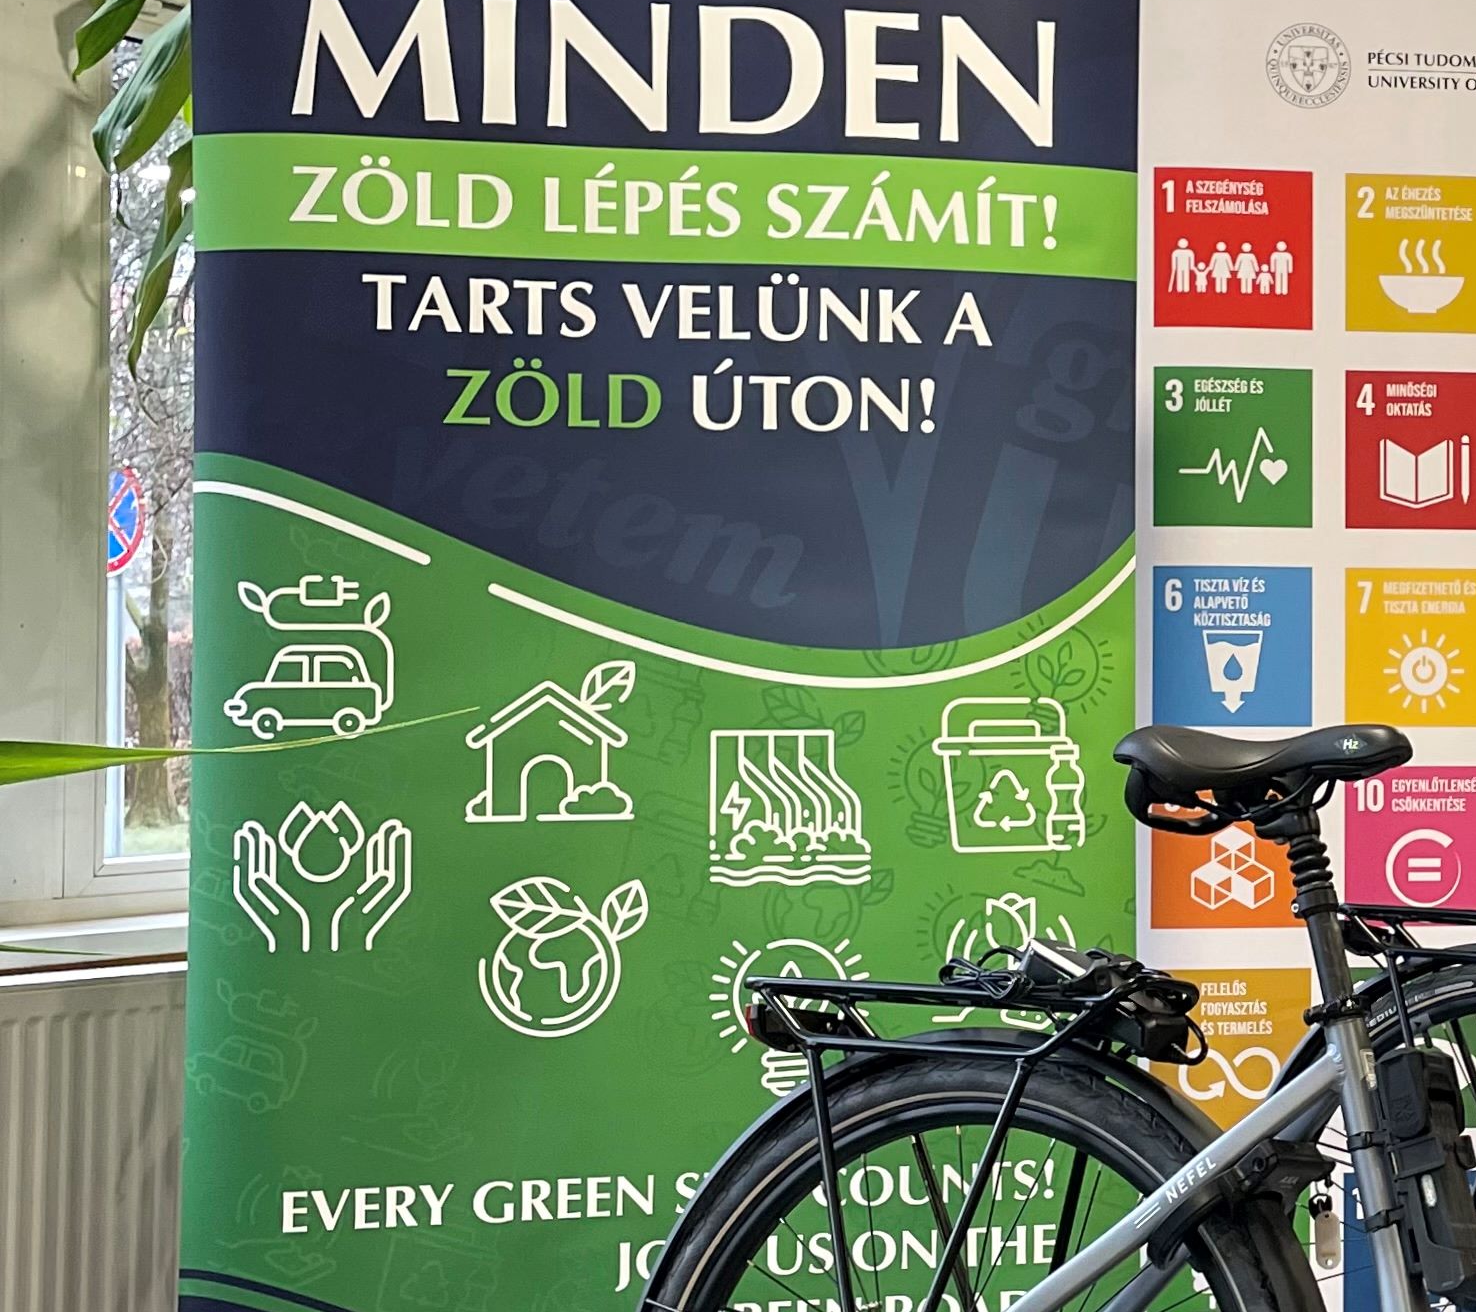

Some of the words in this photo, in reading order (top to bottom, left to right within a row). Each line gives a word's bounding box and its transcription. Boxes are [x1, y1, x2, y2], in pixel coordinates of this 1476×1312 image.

[1367, 49, 1409, 66] PÉCSI
[1367, 75, 1459, 91] UNIVERSITY
[1186, 181, 1194, 194] A
[1195, 179, 1264, 196] SZEGÉNYSÉG
[1385, 187, 1399, 200] AZ
[1402, 185, 1441, 201] ÉHEZÉS
[288, 154, 514, 230] ZÖLD
[543, 163, 742, 238] LÉPÉS
[766, 171, 1059, 250] SZÁMÍT!
[1161, 180, 1175, 213] 1
[1357, 186, 1375, 219] 2
[1186, 198, 1269, 215] FELSZÁMOLÁSA
[361, 274, 598, 336] TARTS
[623, 273, 920, 346] VELÜNK
[943, 291, 992, 347] A
[443, 357, 662, 429] ZÖLD
[691, 357, 937, 433] ÚTON!
[1165, 378, 1184, 412] 3
[1194, 379, 1248, 394] EGÉSZSÉG
[1250, 379, 1264, 394] ÉS
[1386, 381, 1437, 398] MINŐSÉGI
[1194, 397, 1232, 413] JÓLLÉT
[1356, 383, 1376, 416] 4
[1386, 400, 1432, 417] OKTATÁS
[1193, 579, 1230, 593] TISZTA
[1232, 577, 1250, 593] VÍZ
[1251, 578, 1265, 593] ÉS
[1464, 581, 1476, 595] ÉS
[1164, 578, 1183, 612] 6
[1193, 593, 1248, 610] ALAPVETŐ
[1357, 581, 1373, 614] 7
[1384, 600, 1418, 614] TISZTA
[1193, 610, 1271, 627] KÖZTISZTASÁG
[1343, 738, 1359, 751] Hz
[1353, 778, 1384, 812] 10
[1392, 795, 1467, 813] CSÖKKENTÉSE
[1201, 980, 1247, 996] FELELŐS
[1201, 999, 1268, 1016] FOGYASZTÁS
[1201, 1019, 1214, 1035] ÉS
[1217, 1019, 1273, 1035] TERMELÉS
[1165, 1156, 1217, 1203] NEFEL
[281, 1182, 458, 1233] EVERY
[472, 1174, 655, 1226] GREEN
[766, 1230, 834, 1276] US
[851, 1229, 944, 1273] ON
[962, 1223, 1057, 1267] THE
